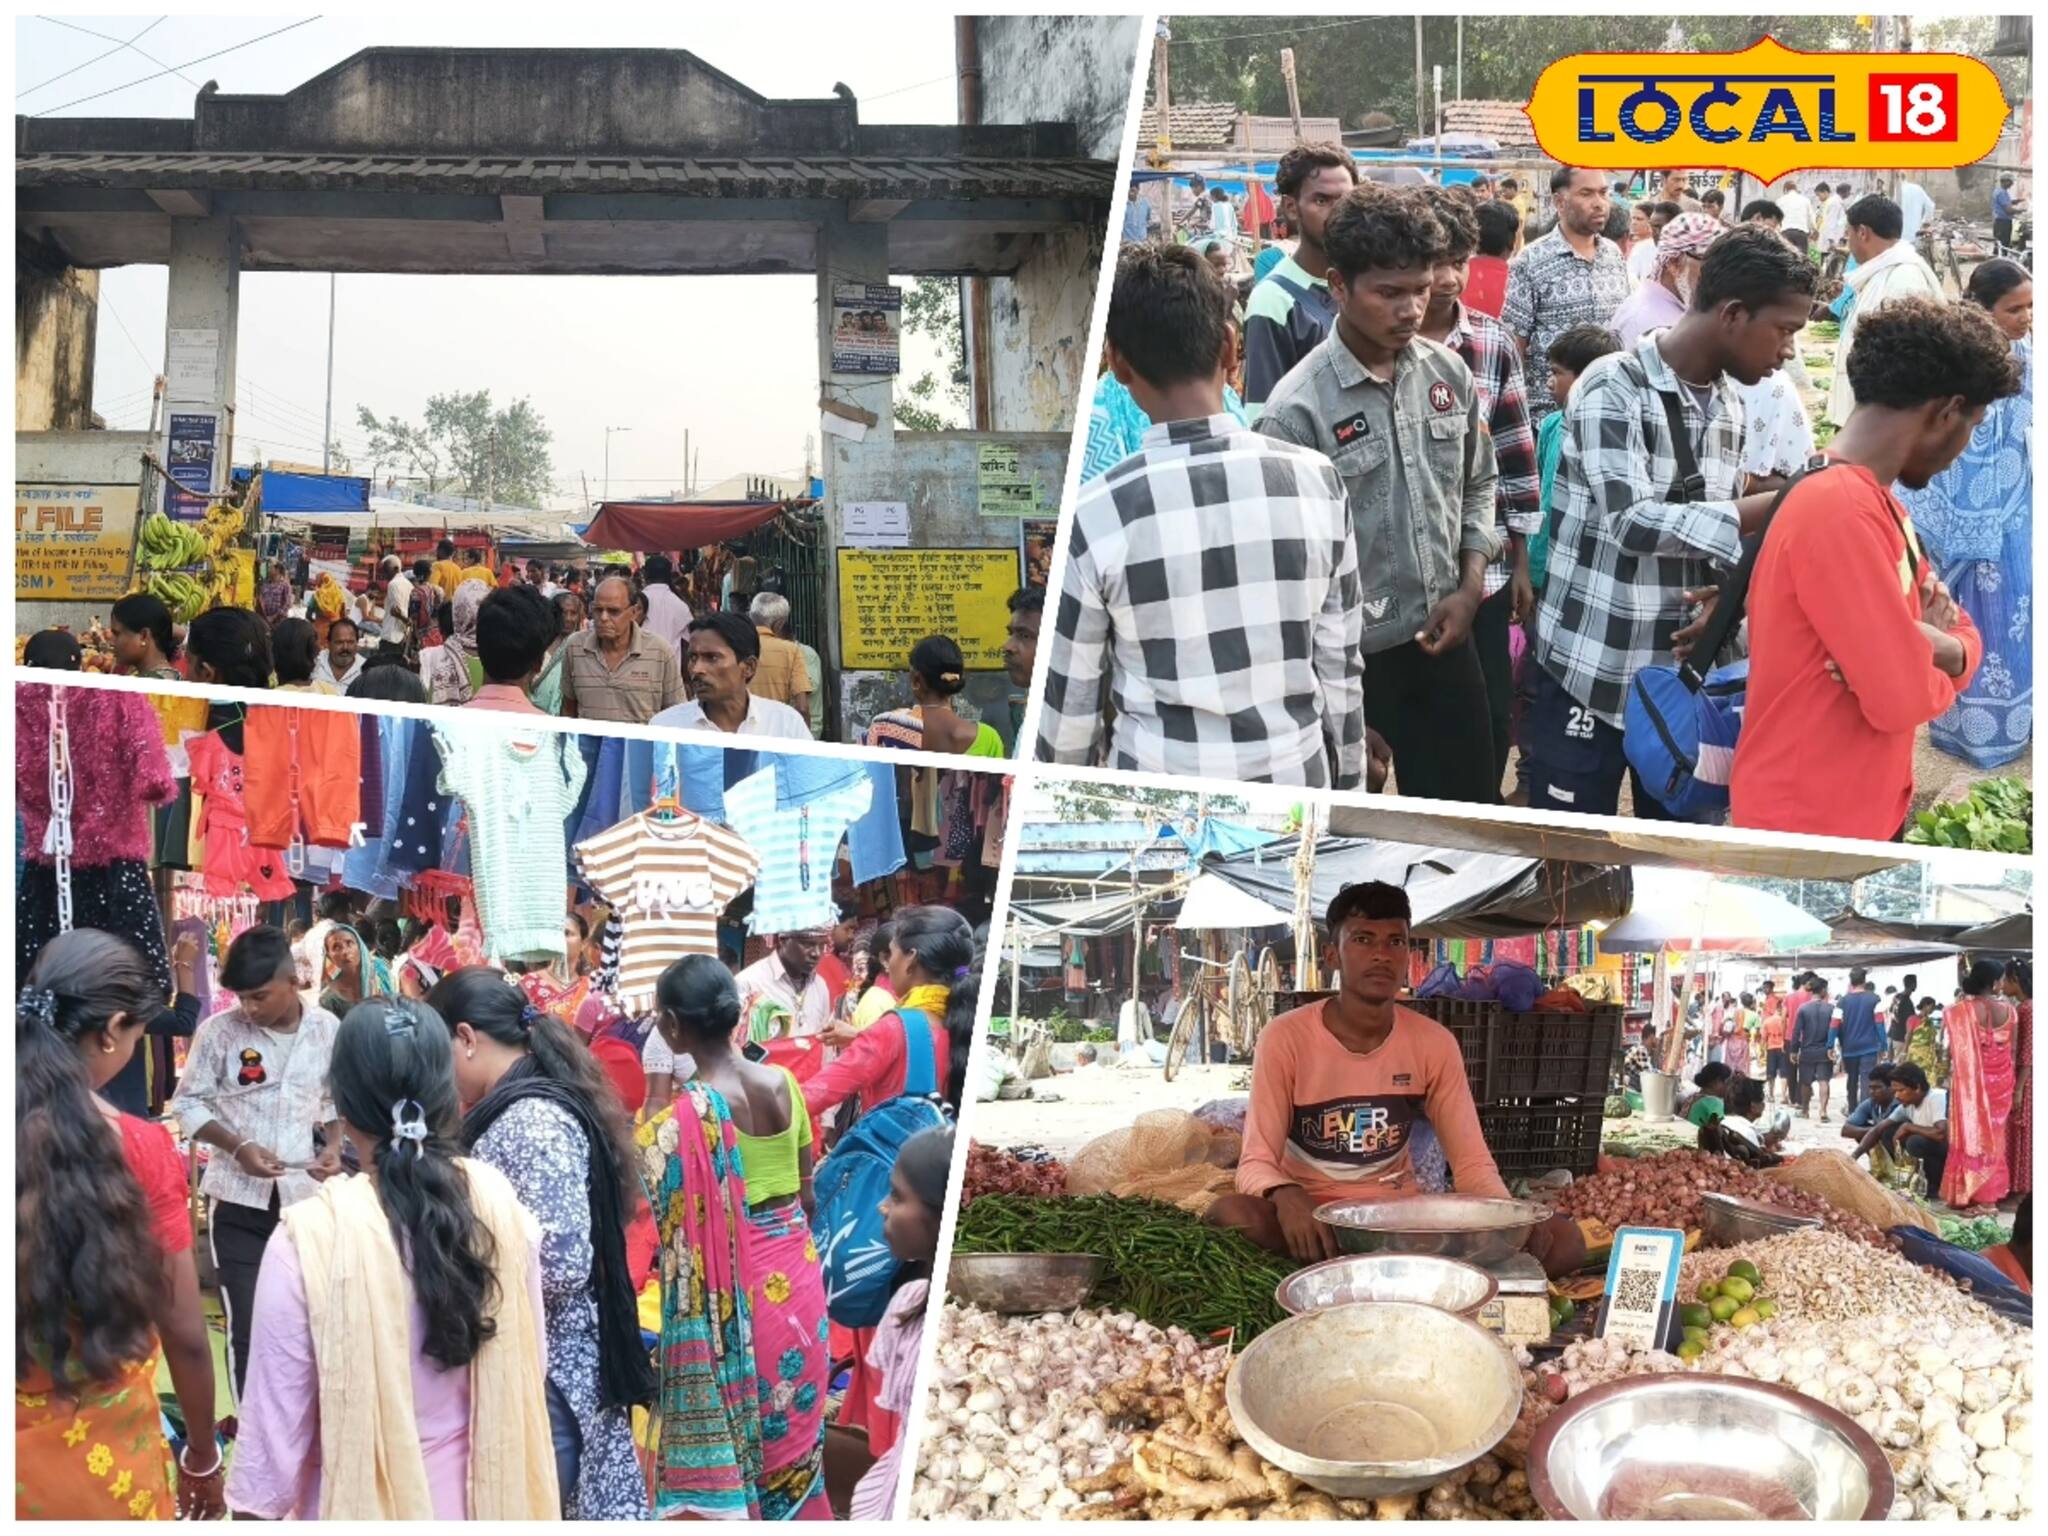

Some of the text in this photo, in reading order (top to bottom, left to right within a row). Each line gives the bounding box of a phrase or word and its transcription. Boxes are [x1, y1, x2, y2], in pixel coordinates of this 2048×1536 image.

[36, 506, 103, 531] FILE
[1567, 706, 1595, 732] 25
[1301, 1107, 1389, 1141] NEVER
